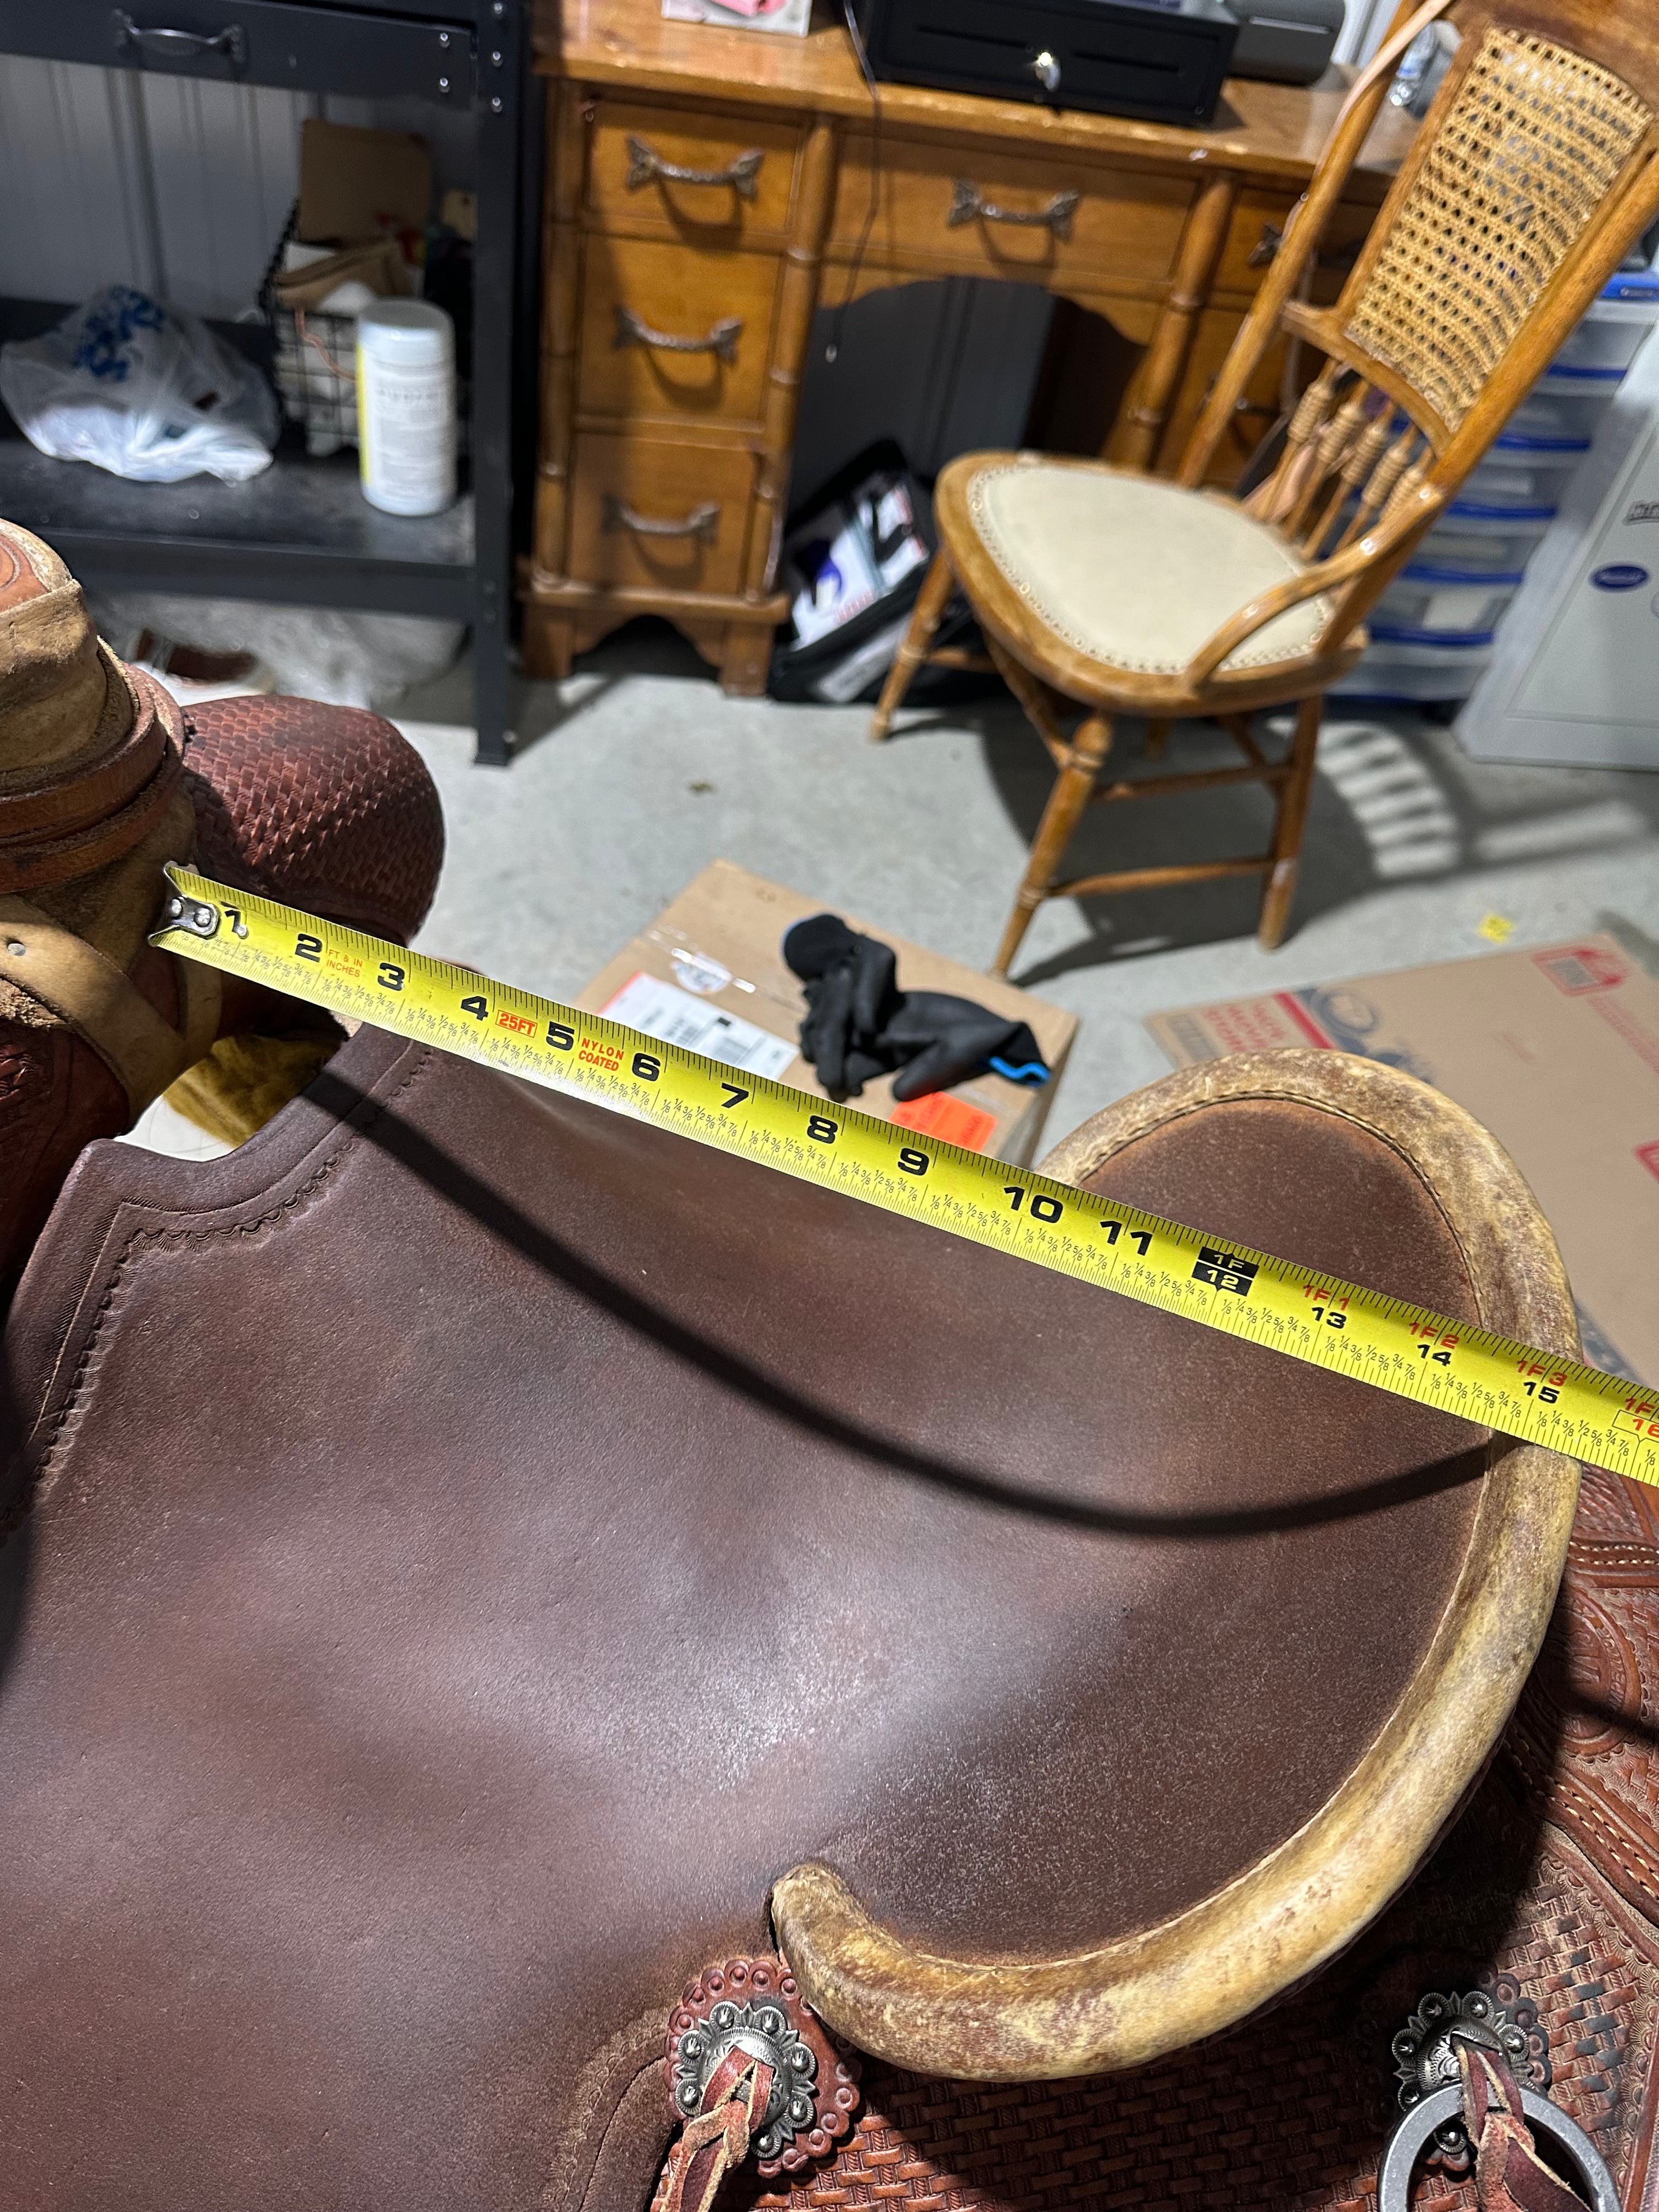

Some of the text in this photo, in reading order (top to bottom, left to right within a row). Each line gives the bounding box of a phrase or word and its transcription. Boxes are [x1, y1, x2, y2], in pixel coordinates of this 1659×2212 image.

[295, 934, 323, 963] 2
[329, 949, 340, 958] FT
[354, 958, 363, 967] IN
[326, 959, 361, 978] INCHES
[377, 962, 405, 991] 3
[321, 978, 395, 1014] 1/8 1/4 3/8 1/2 5/8 3/4 7/8
[460, 996, 488, 1021] 4
[405, 1008, 478, 1043] 1/8 1/4 3/8 1/2 5/8 3/4 7/8
[499, 1013, 535, 1035] 25FT
[546, 1021, 575, 1051] 5
[489, 1037, 563, 1074] 1/8 1/4 3/8 1/2 5/8 3/4 7/8
[578, 1050, 619, 1071] COATED
[582, 1039, 624, 1060] NYLON
[631, 1053, 661, 1081] 6
[575, 1068, 650, 1105] 1/8 1/4 3/8 1/2 5/8 3/4 7/8
[720, 1082, 749, 1109] 7
[661, 1098, 737, 1137] 1/8 1/4 3/8 1/2 5/8 3/4 7/8
[807, 1115, 838, 1144] 8
[749, 1130, 826, 1169] 1/8 1/4 3/8 1/2 5/8 3/4 7/8
[898, 1147, 929, 1176] 9
[839, 1162, 917, 1201] 1/8 1/4 3/8 1/2 5/8 3/4 7/8
[930, 1194, 1011, 1235] 1/8 1/4 3/8 1/2 5/8 3/4 7/8
[1003, 1186, 1063, 1223] 10
[1024, 1228, 1107, 1269] 1/8 1/4 3/8 1/2 5/8 3/4 7/8
[1100, 1220, 1152, 1256] 11
[1121, 1262, 1207, 1305] 1/8 1/4 3/8 1/2 5/8 3/4 7/8
[1206, 1269, 1239, 1290] 12
[1221, 1298, 1310, 1342] 1/8 1/4 3/8 1/2 5/8 3/4 7/8
[1311, 1306, 1346, 1329] 13
[1325, 1335, 1415, 1380] 1/8 1/4 3/8 1/2 5/8 3/4 7/8
[1417, 1344, 1453, 1367] 14
[1430, 1373, 1521, 1418] 1/8 1/4 3/8 1/2 5/8 3/4 7/8
[1523, 1381, 1560, 1403] 15
[1537, 1410, 1629, 1456] 1/8 1/4 3/8 1/2 5/8 3/4 7/8
[1645, 1449, 1656, 1465] 1/8
